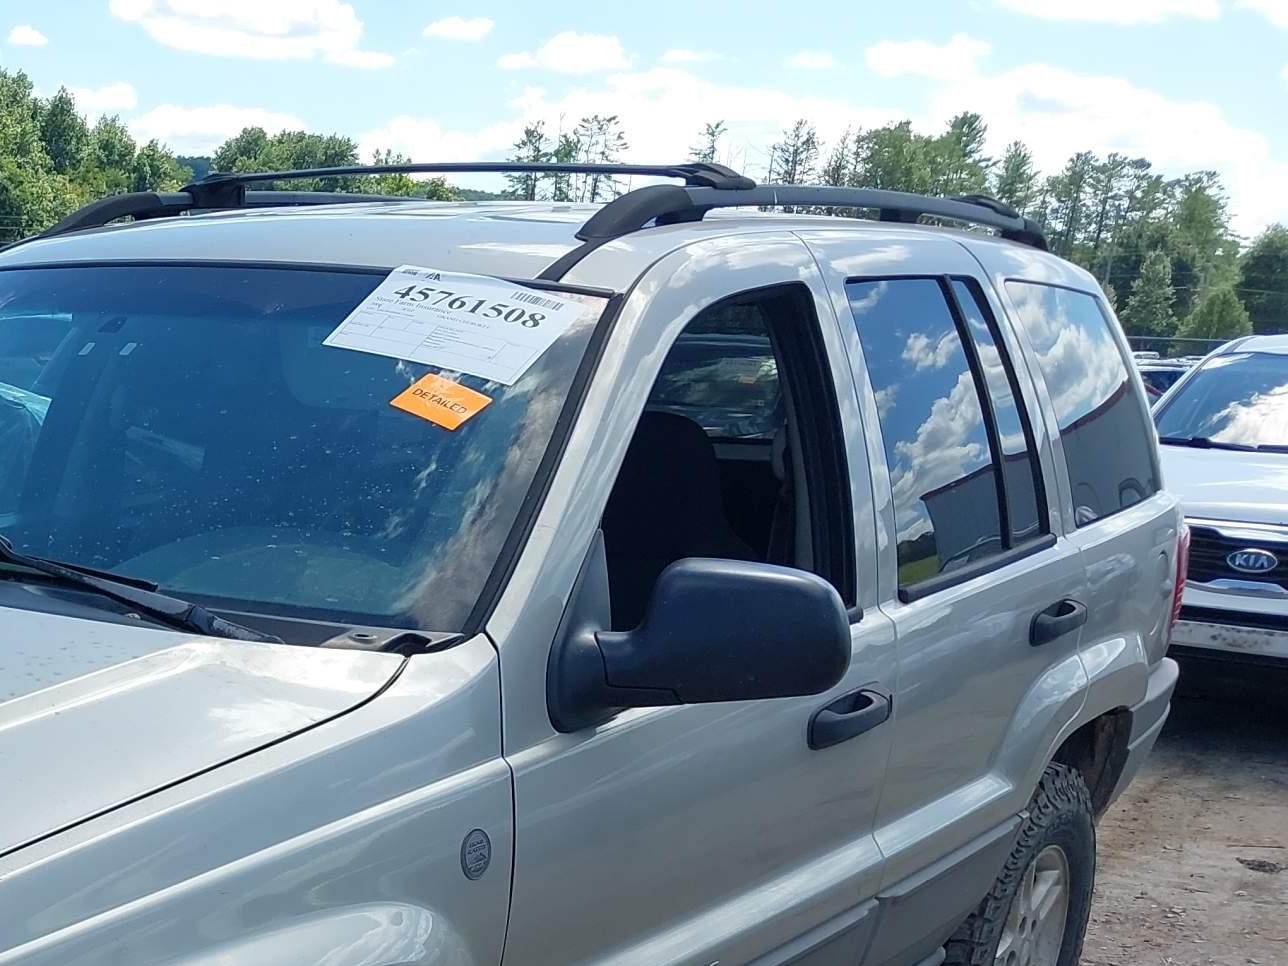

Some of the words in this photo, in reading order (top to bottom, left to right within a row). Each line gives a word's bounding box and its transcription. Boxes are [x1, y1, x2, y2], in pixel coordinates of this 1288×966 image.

[393, 284, 547, 329] 45761508
[411, 387, 468, 415] DETAILED
[1234, 553, 1269, 569] KIA
